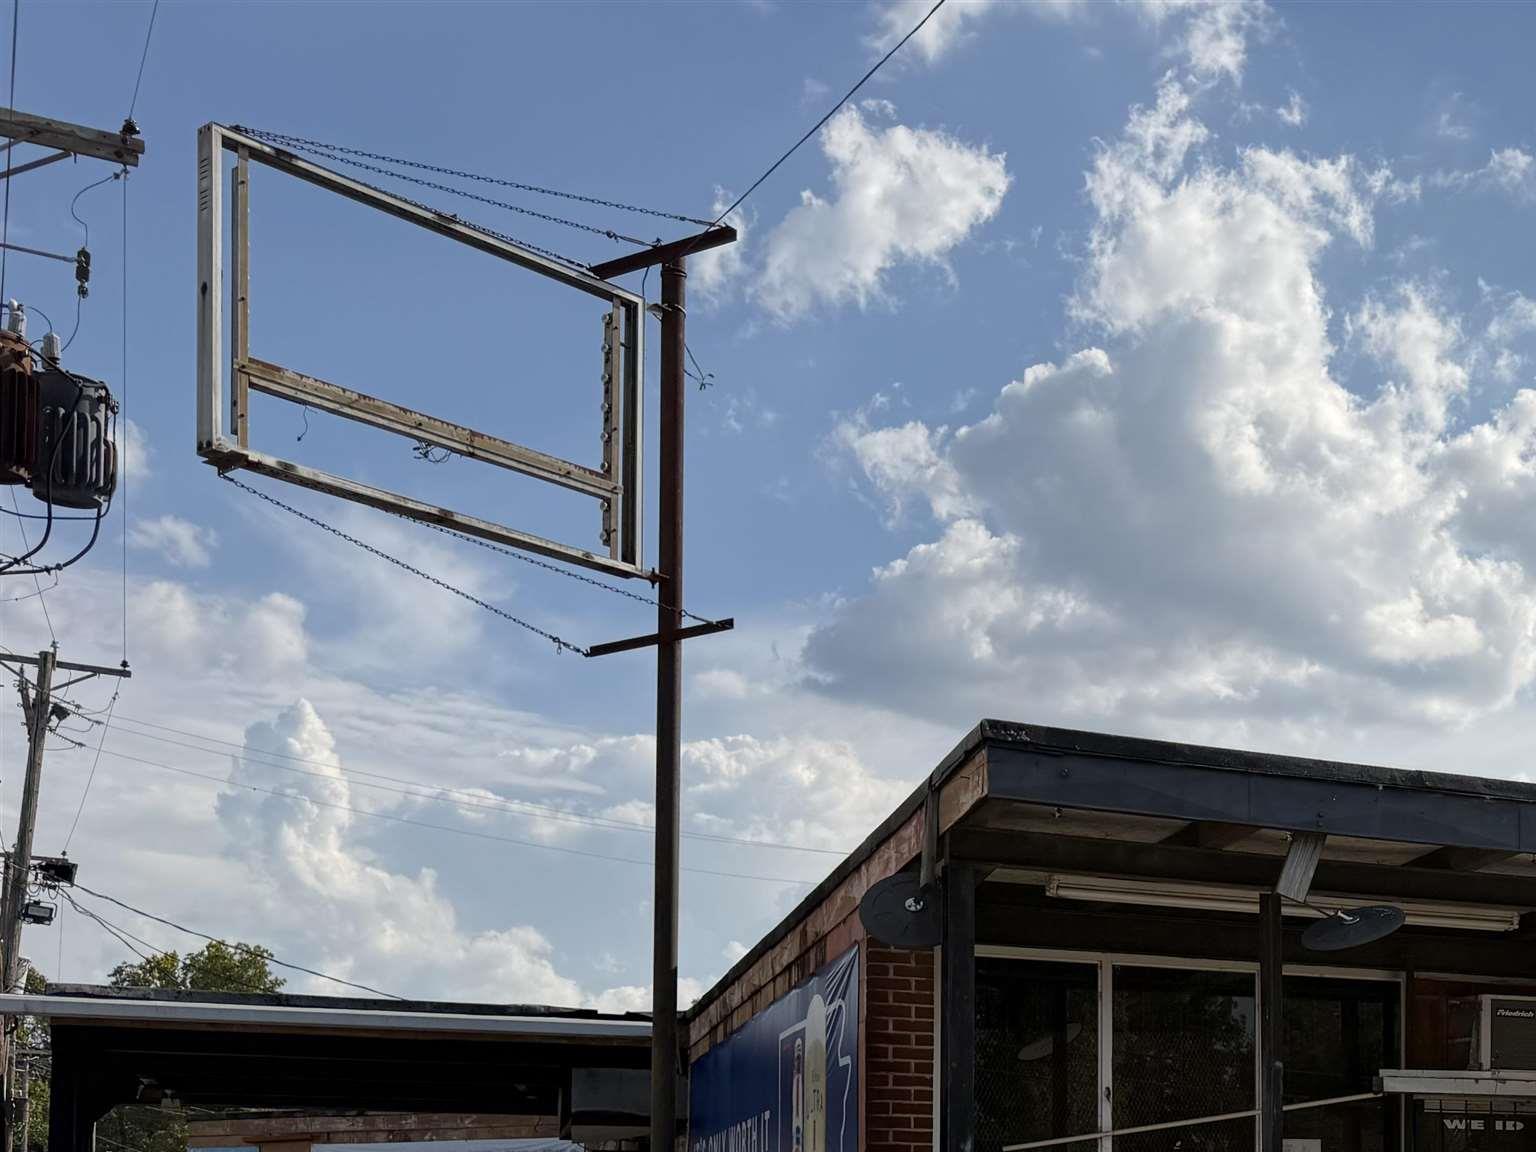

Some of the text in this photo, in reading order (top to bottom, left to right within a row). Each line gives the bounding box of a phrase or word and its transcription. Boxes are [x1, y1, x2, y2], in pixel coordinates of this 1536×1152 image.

[761, 1110, 770, 1152] IT
[1443, 1119, 1526, 1131] WE ID
